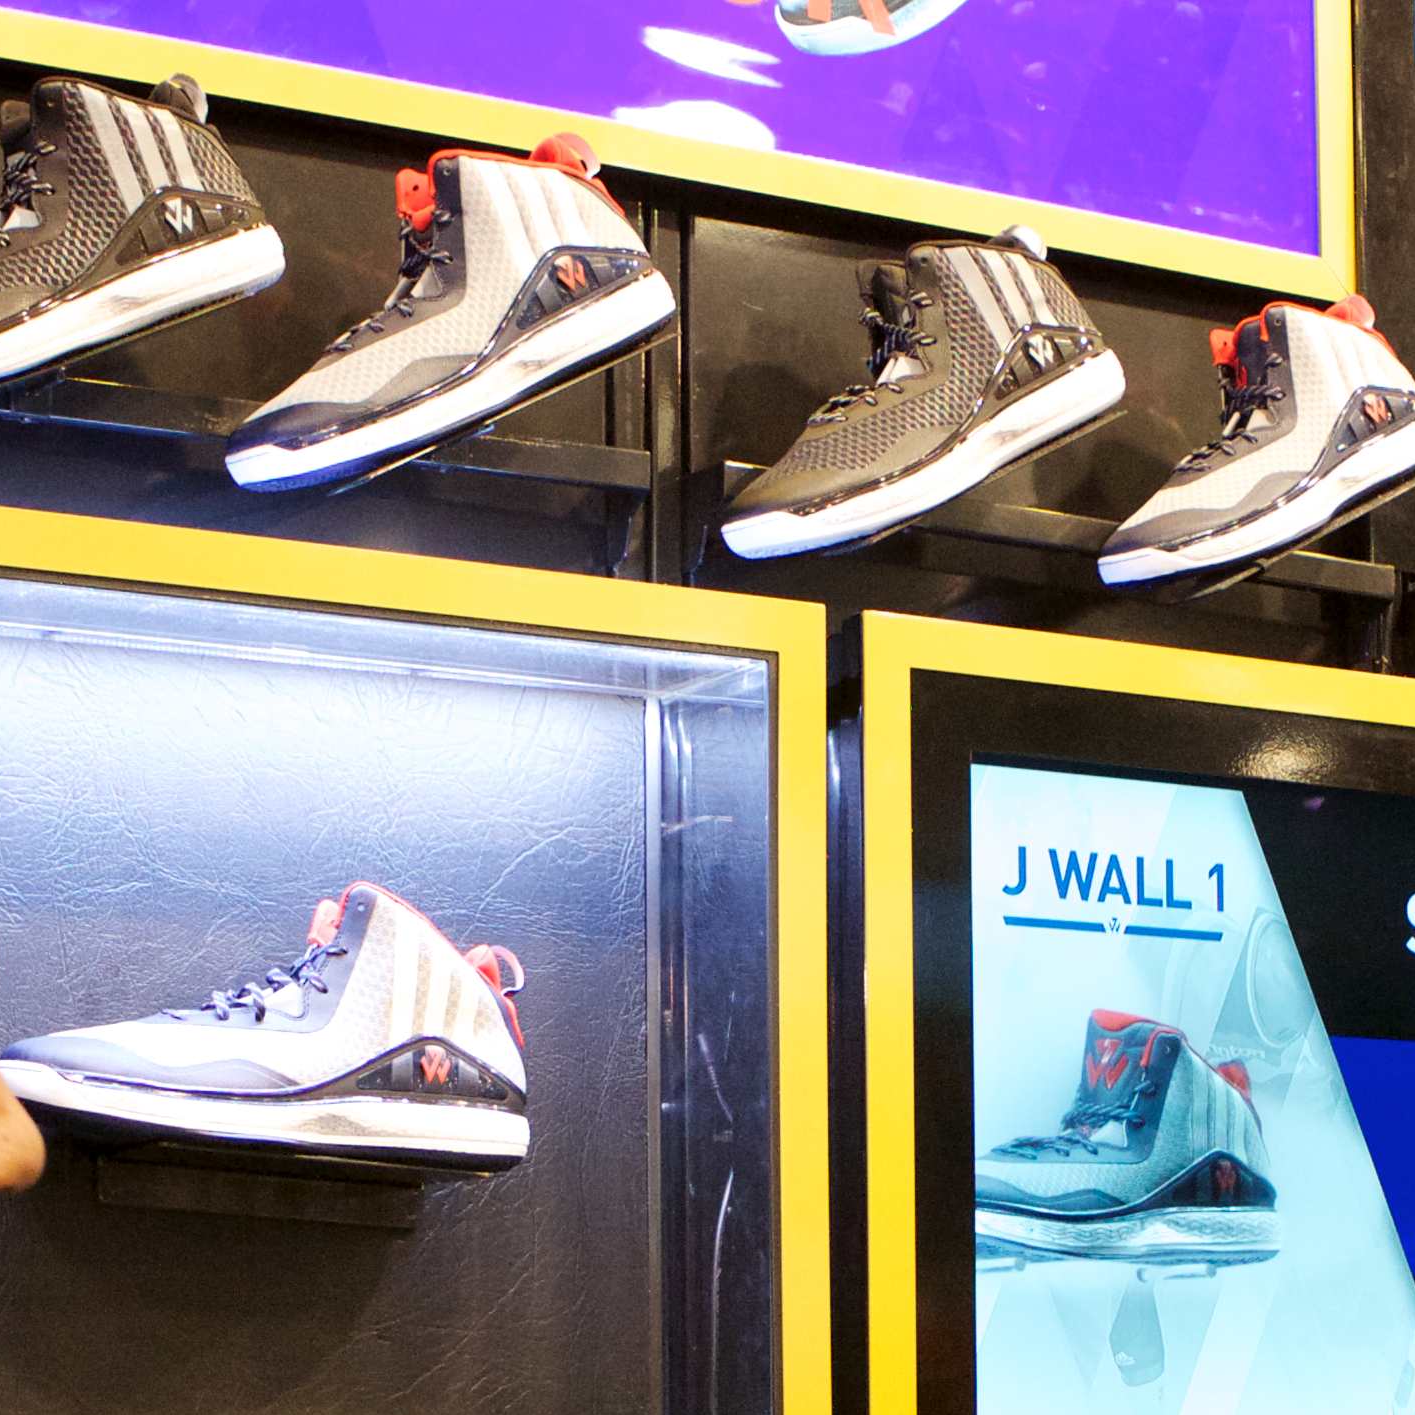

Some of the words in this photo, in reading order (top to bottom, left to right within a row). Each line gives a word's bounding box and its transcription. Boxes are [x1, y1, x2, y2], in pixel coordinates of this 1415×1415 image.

[1002, 846, 1027, 895] J
[1048, 848, 1193, 910] WALL
[1208, 863, 1225, 912] 1
